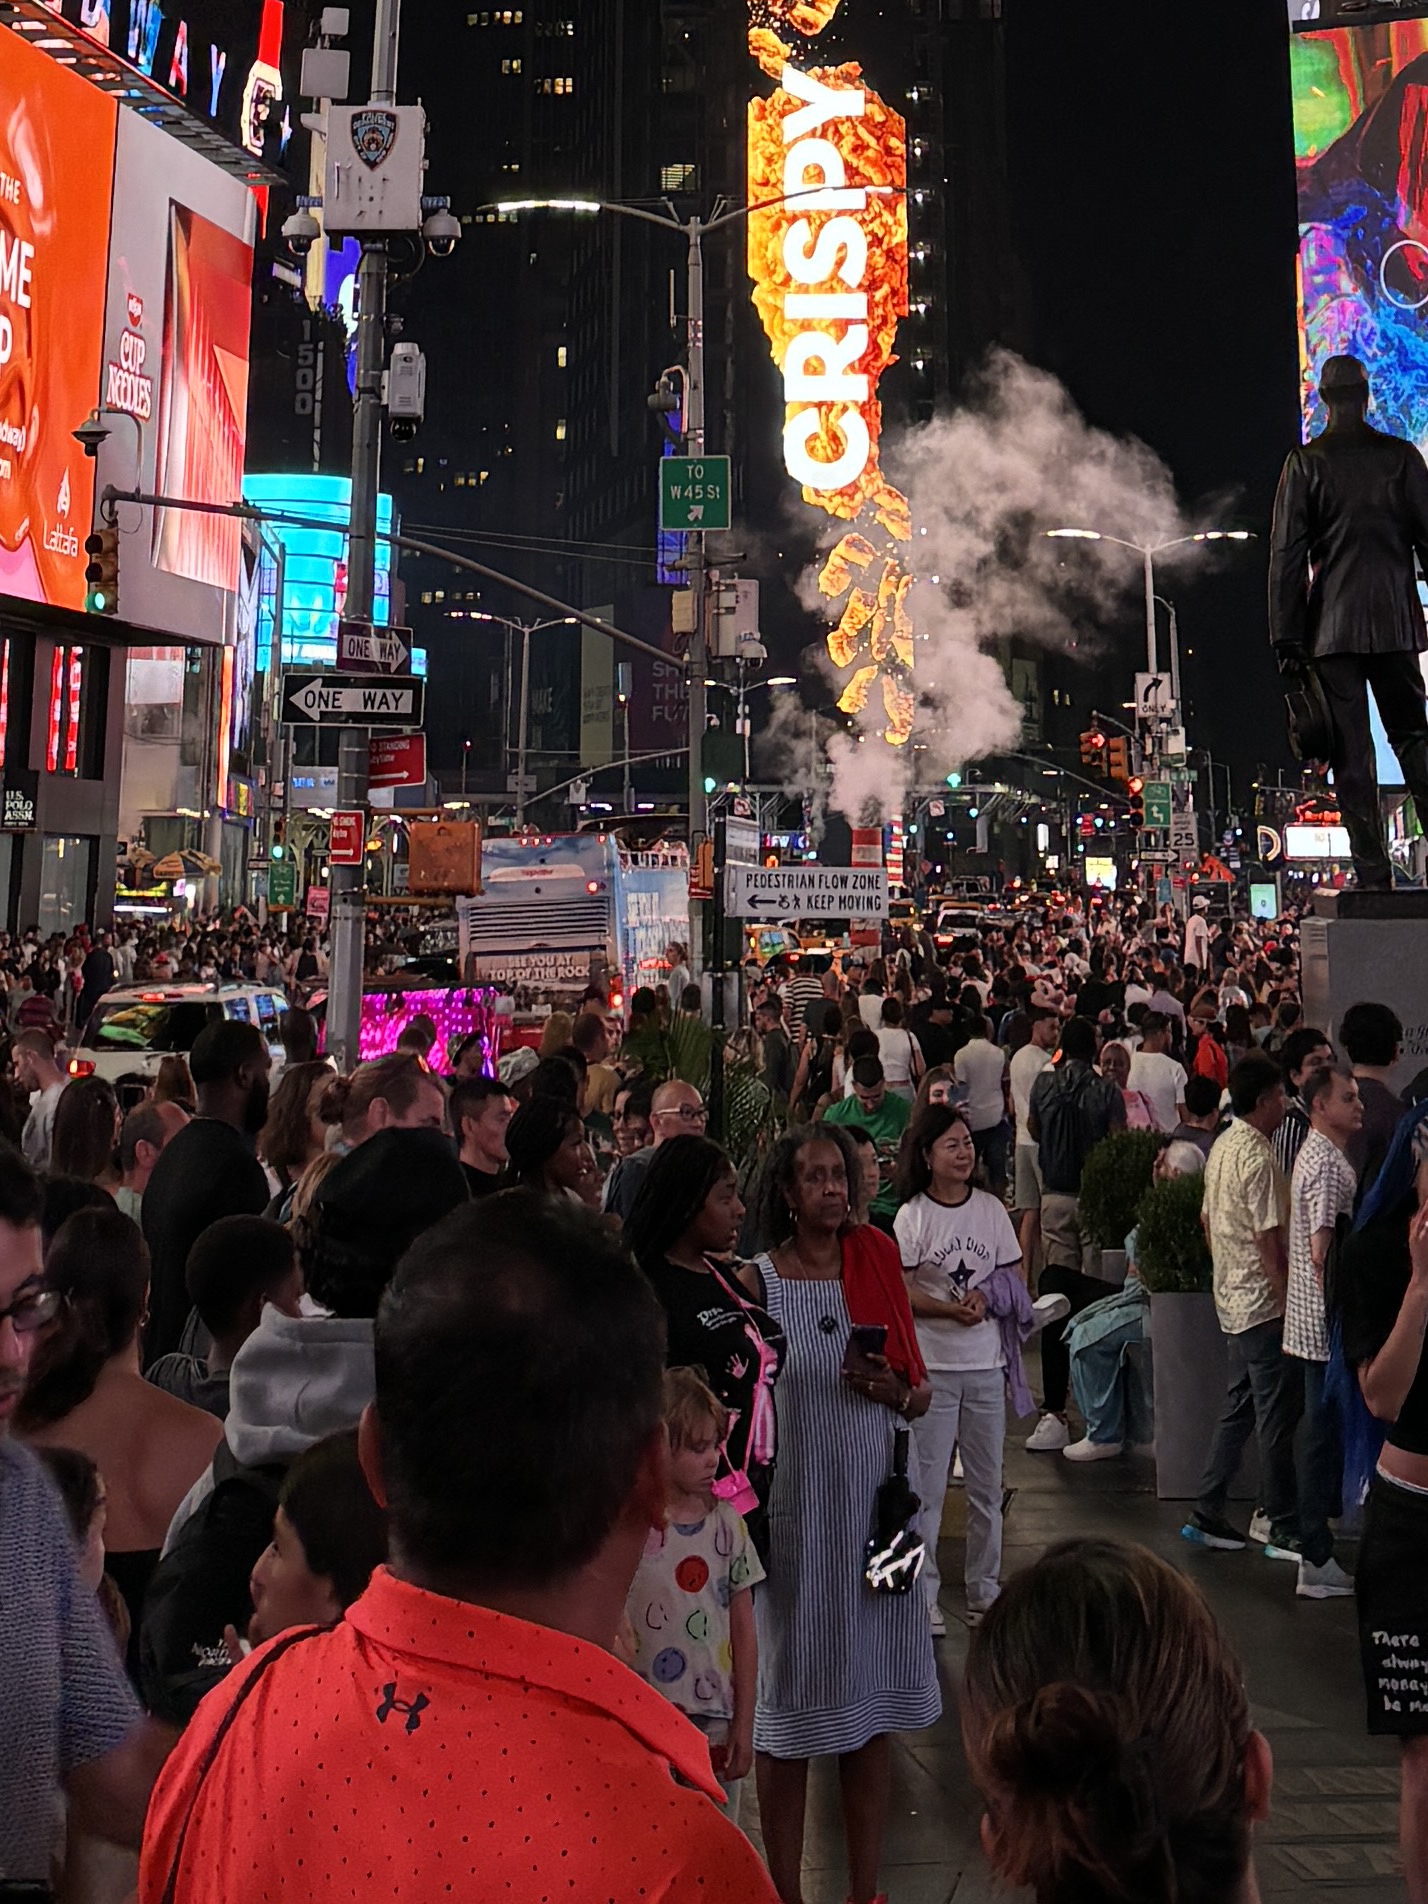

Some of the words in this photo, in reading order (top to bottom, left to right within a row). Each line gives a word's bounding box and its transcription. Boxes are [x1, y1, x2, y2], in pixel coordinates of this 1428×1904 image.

[0, 170, 21, 206] THE
[783, 61, 872, 493] CRISPY
[120, 329, 147, 374] CUP
[294, 318, 316, 416] 1500
[686, 464, 705, 479] TO
[670, 485, 682, 500] W
[684, 484, 704, 500] 45
[707, 484, 721, 500] St
[42, 516, 79, 558] Lattafa
[347, 637, 371, 658] ONE
[378, 639, 402, 661] WAY
[304, 689, 343, 709] ONE
[362, 691, 405, 711] WAY
[1141, 703, 1168, 714] ONLY
[5, 800, 33, 811] POLO
[4, 810, 35, 821] ASSN.
[1173, 831, 1196, 847] 25
[746, 873, 816, 890] PEDESTRIAN
[818, 873, 849, 890] FLOW
[852, 873, 882, 890] ZONE
[806, 894, 835, 911] KEEP
[838, 894, 882, 911] MOVING
[529, 954, 554, 967] YOU
[555, 954, 573, 966] AT
[488, 967, 515, 981] TOP
[1372, 1630, 1421, 1648] There
[1383, 1694, 1402, 1712] be
